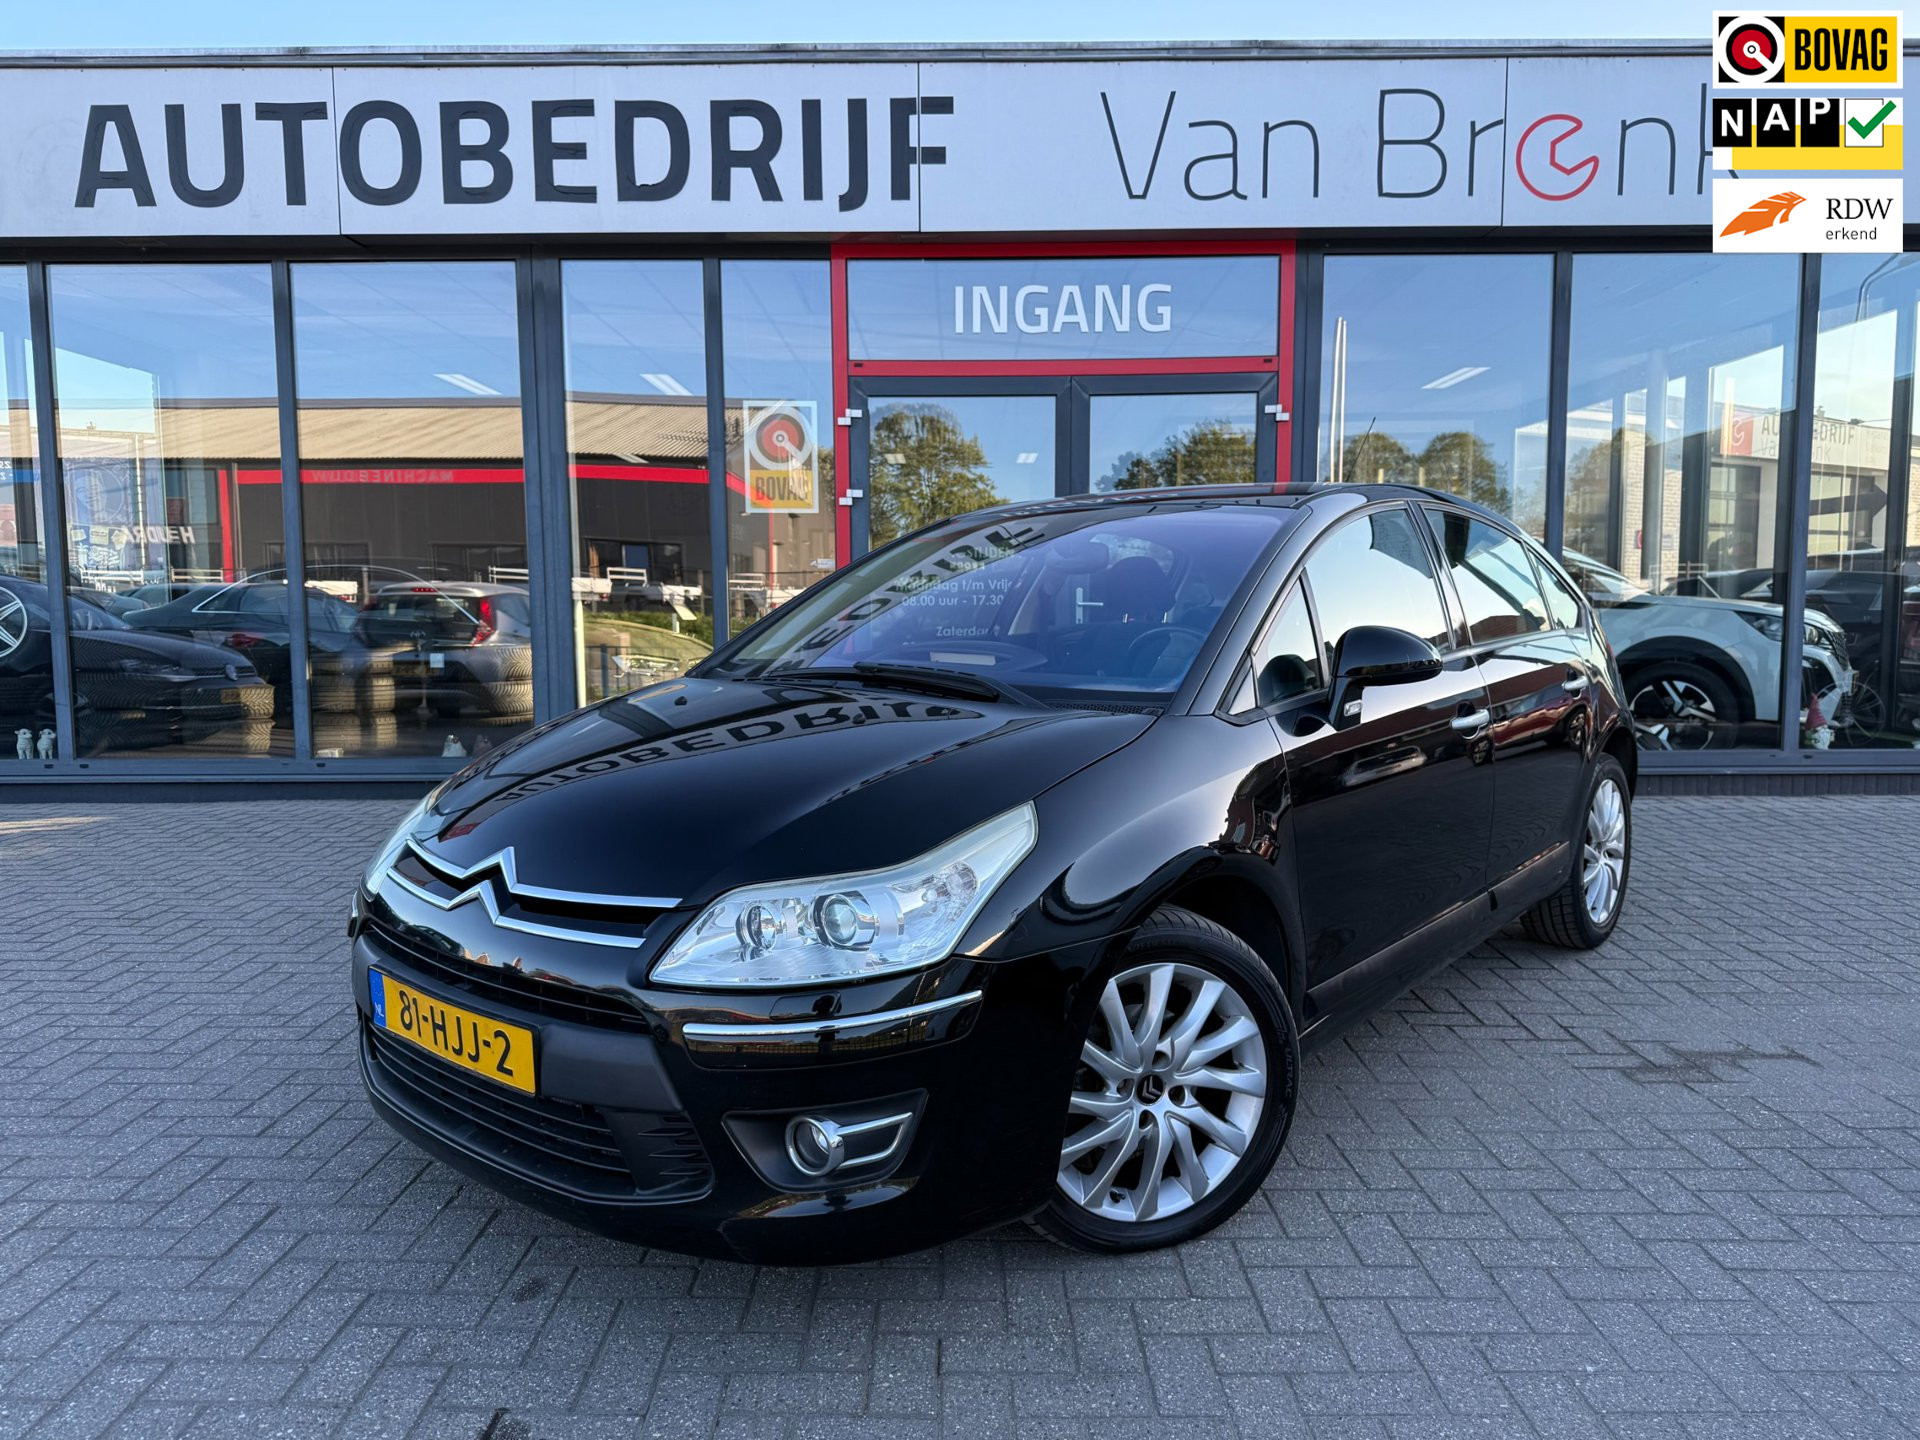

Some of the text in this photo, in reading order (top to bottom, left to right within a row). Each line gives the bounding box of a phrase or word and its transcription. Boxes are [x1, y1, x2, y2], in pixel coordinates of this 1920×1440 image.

[75, 96, 954, 211] AUTOBEDRIJF
[1100, 91, 1319, 201] Van
[955, 284, 1172, 333] INGANG
[755, 476, 808, 500] BOVAG
[962, 578, 985, 591] t/m
[902, 595, 935, 606] 08.00
[938, 597, 958, 606] uur
[973, 595, 1004, 606] 17.30
[374, 1002, 385, 1017] NL
[398, 989, 514, 1077] 81-HJJ-2
